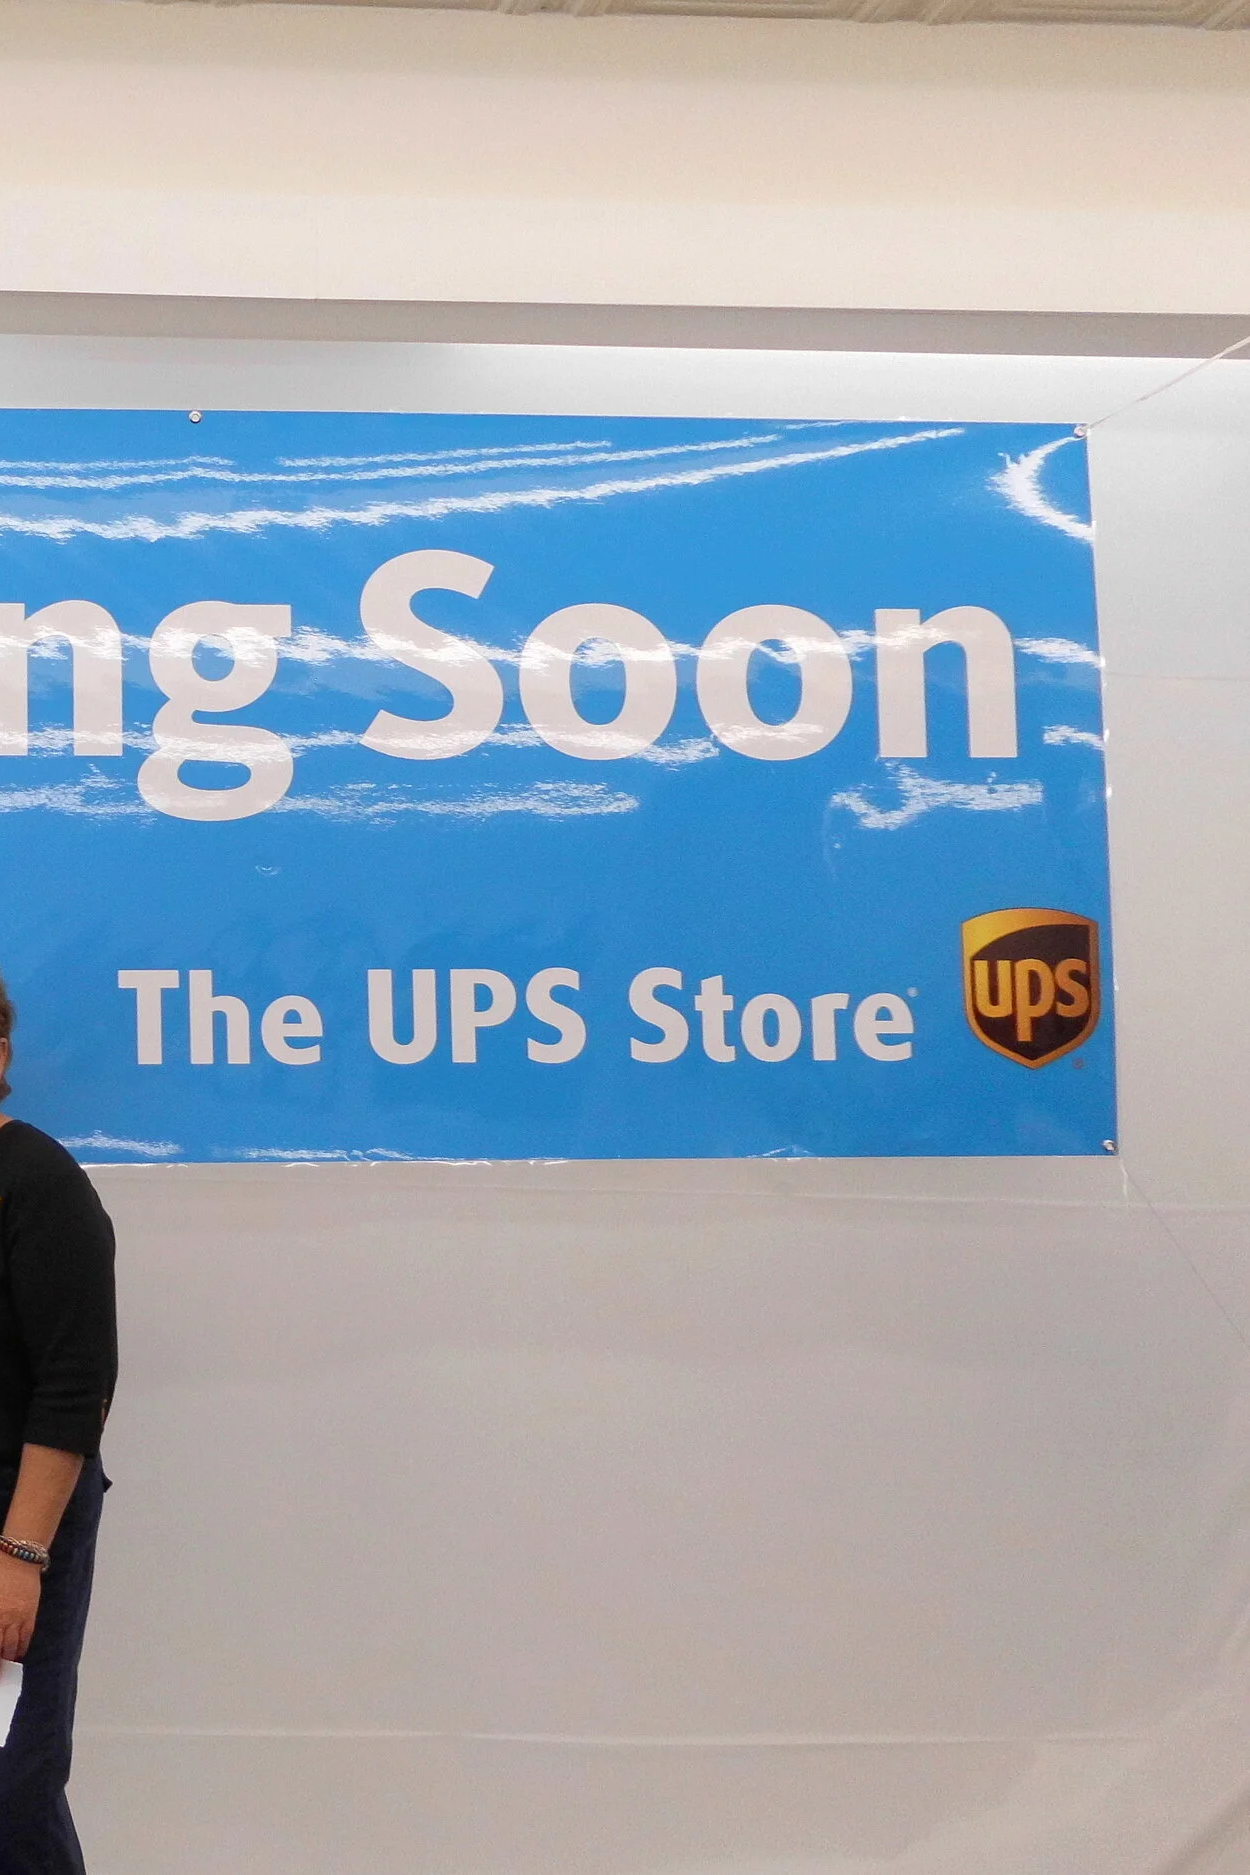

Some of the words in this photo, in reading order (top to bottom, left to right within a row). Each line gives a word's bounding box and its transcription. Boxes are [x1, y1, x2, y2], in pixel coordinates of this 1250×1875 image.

[359, 549, 1017, 760] Soon
[117, 968, 323, 1065] The
[367, 967, 587, 1065] UPS
[629, 966, 916, 1064] Store
